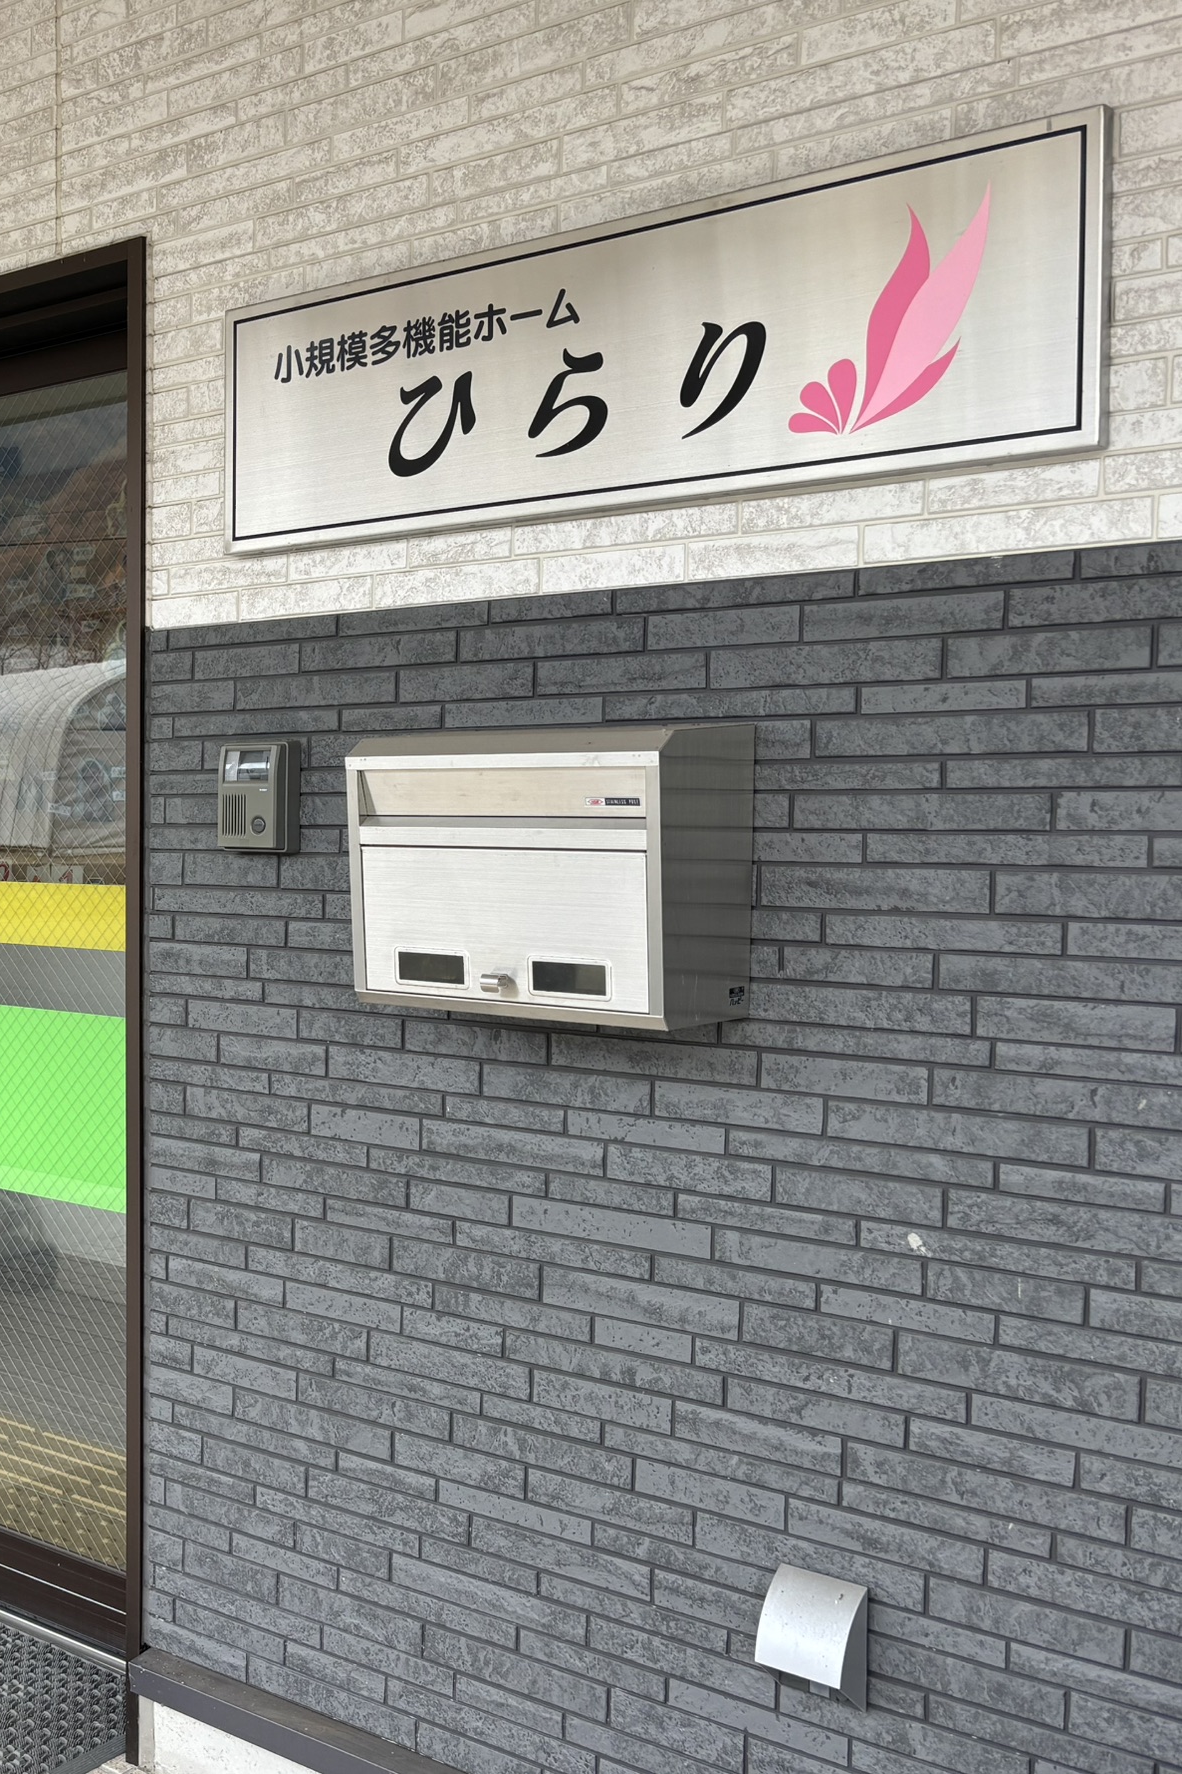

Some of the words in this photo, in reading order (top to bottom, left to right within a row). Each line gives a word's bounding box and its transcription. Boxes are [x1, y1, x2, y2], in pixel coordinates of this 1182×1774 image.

[274, 287, 581, 385] 小規模多機能ホーム
[388, 321, 767, 478] ひらり
